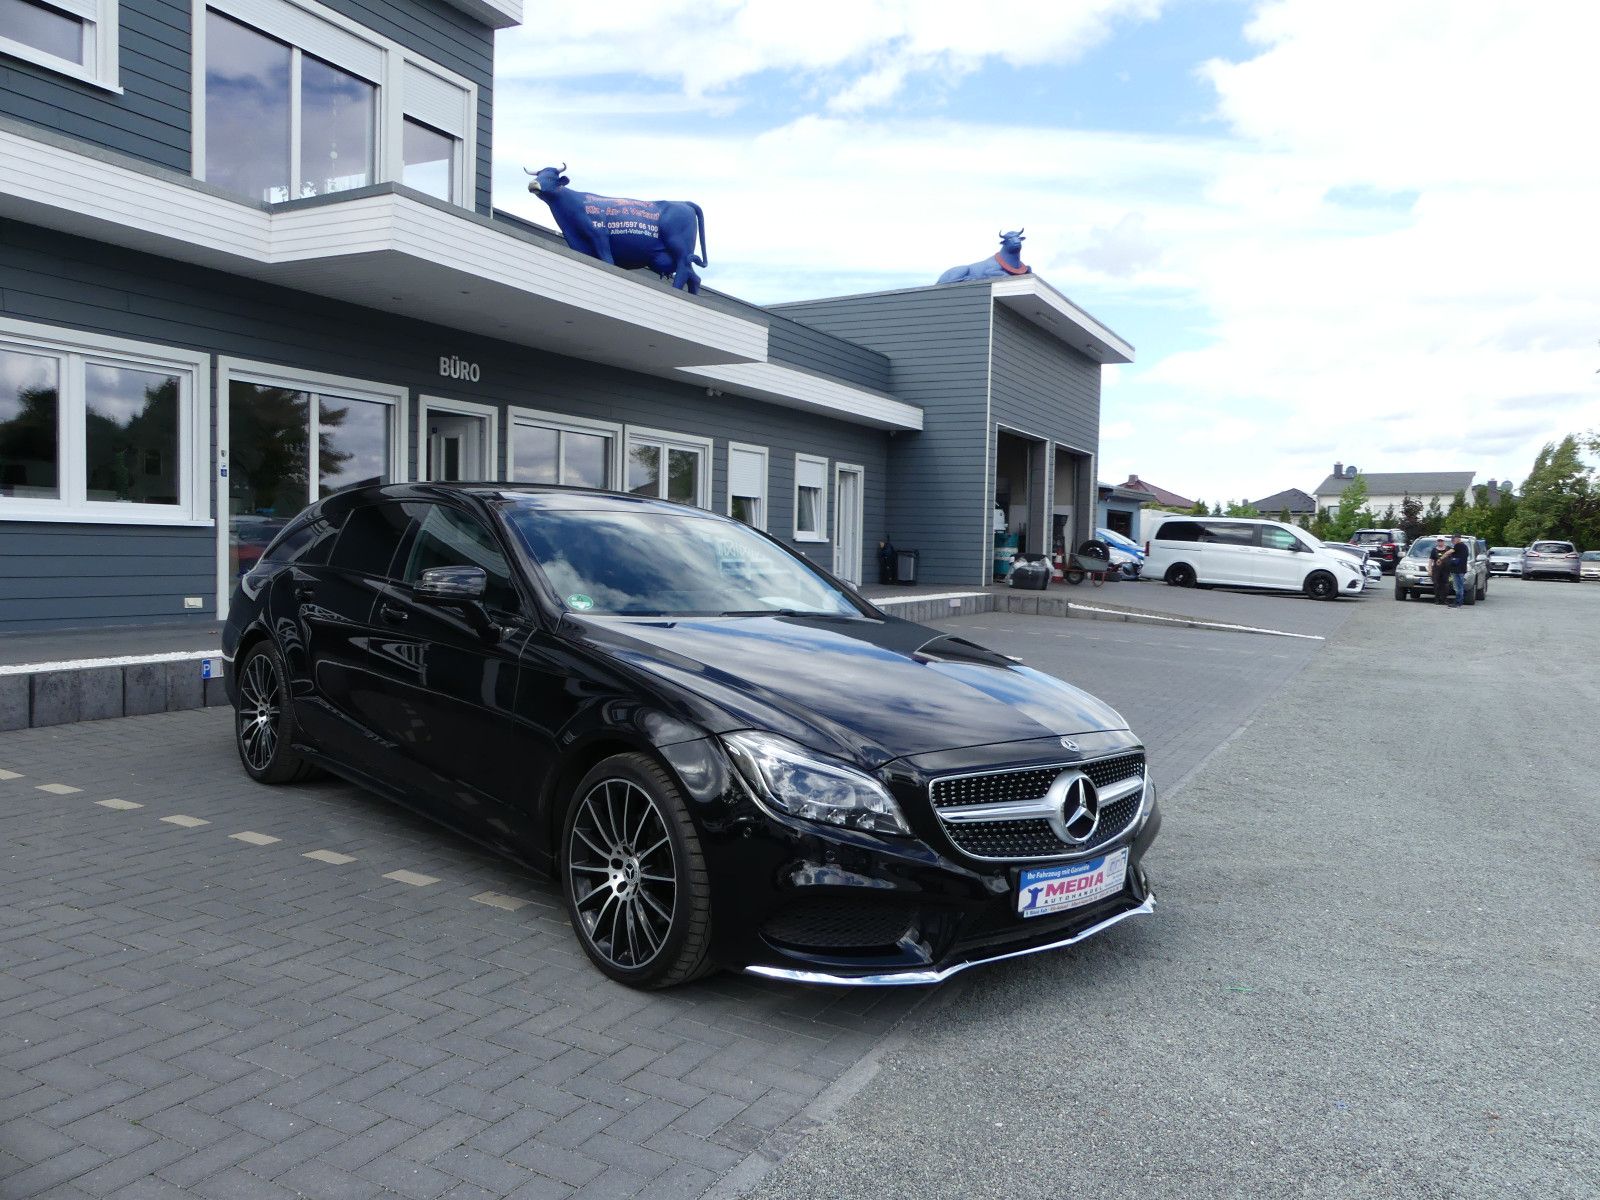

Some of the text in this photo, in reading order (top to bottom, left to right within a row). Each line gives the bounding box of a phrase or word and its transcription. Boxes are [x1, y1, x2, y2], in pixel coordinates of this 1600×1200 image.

[607, 221, 638, 229] 0391/597
[647, 224, 659, 232] 100
[440, 355, 480, 382] BÜRO
[1036, 870, 1061, 879] Fahrzeug
[1061, 867, 1071, 875] mit
[1045, 871, 1104, 897] MEDIA
[1044, 887, 1102, 905] AUTOHANDEL
